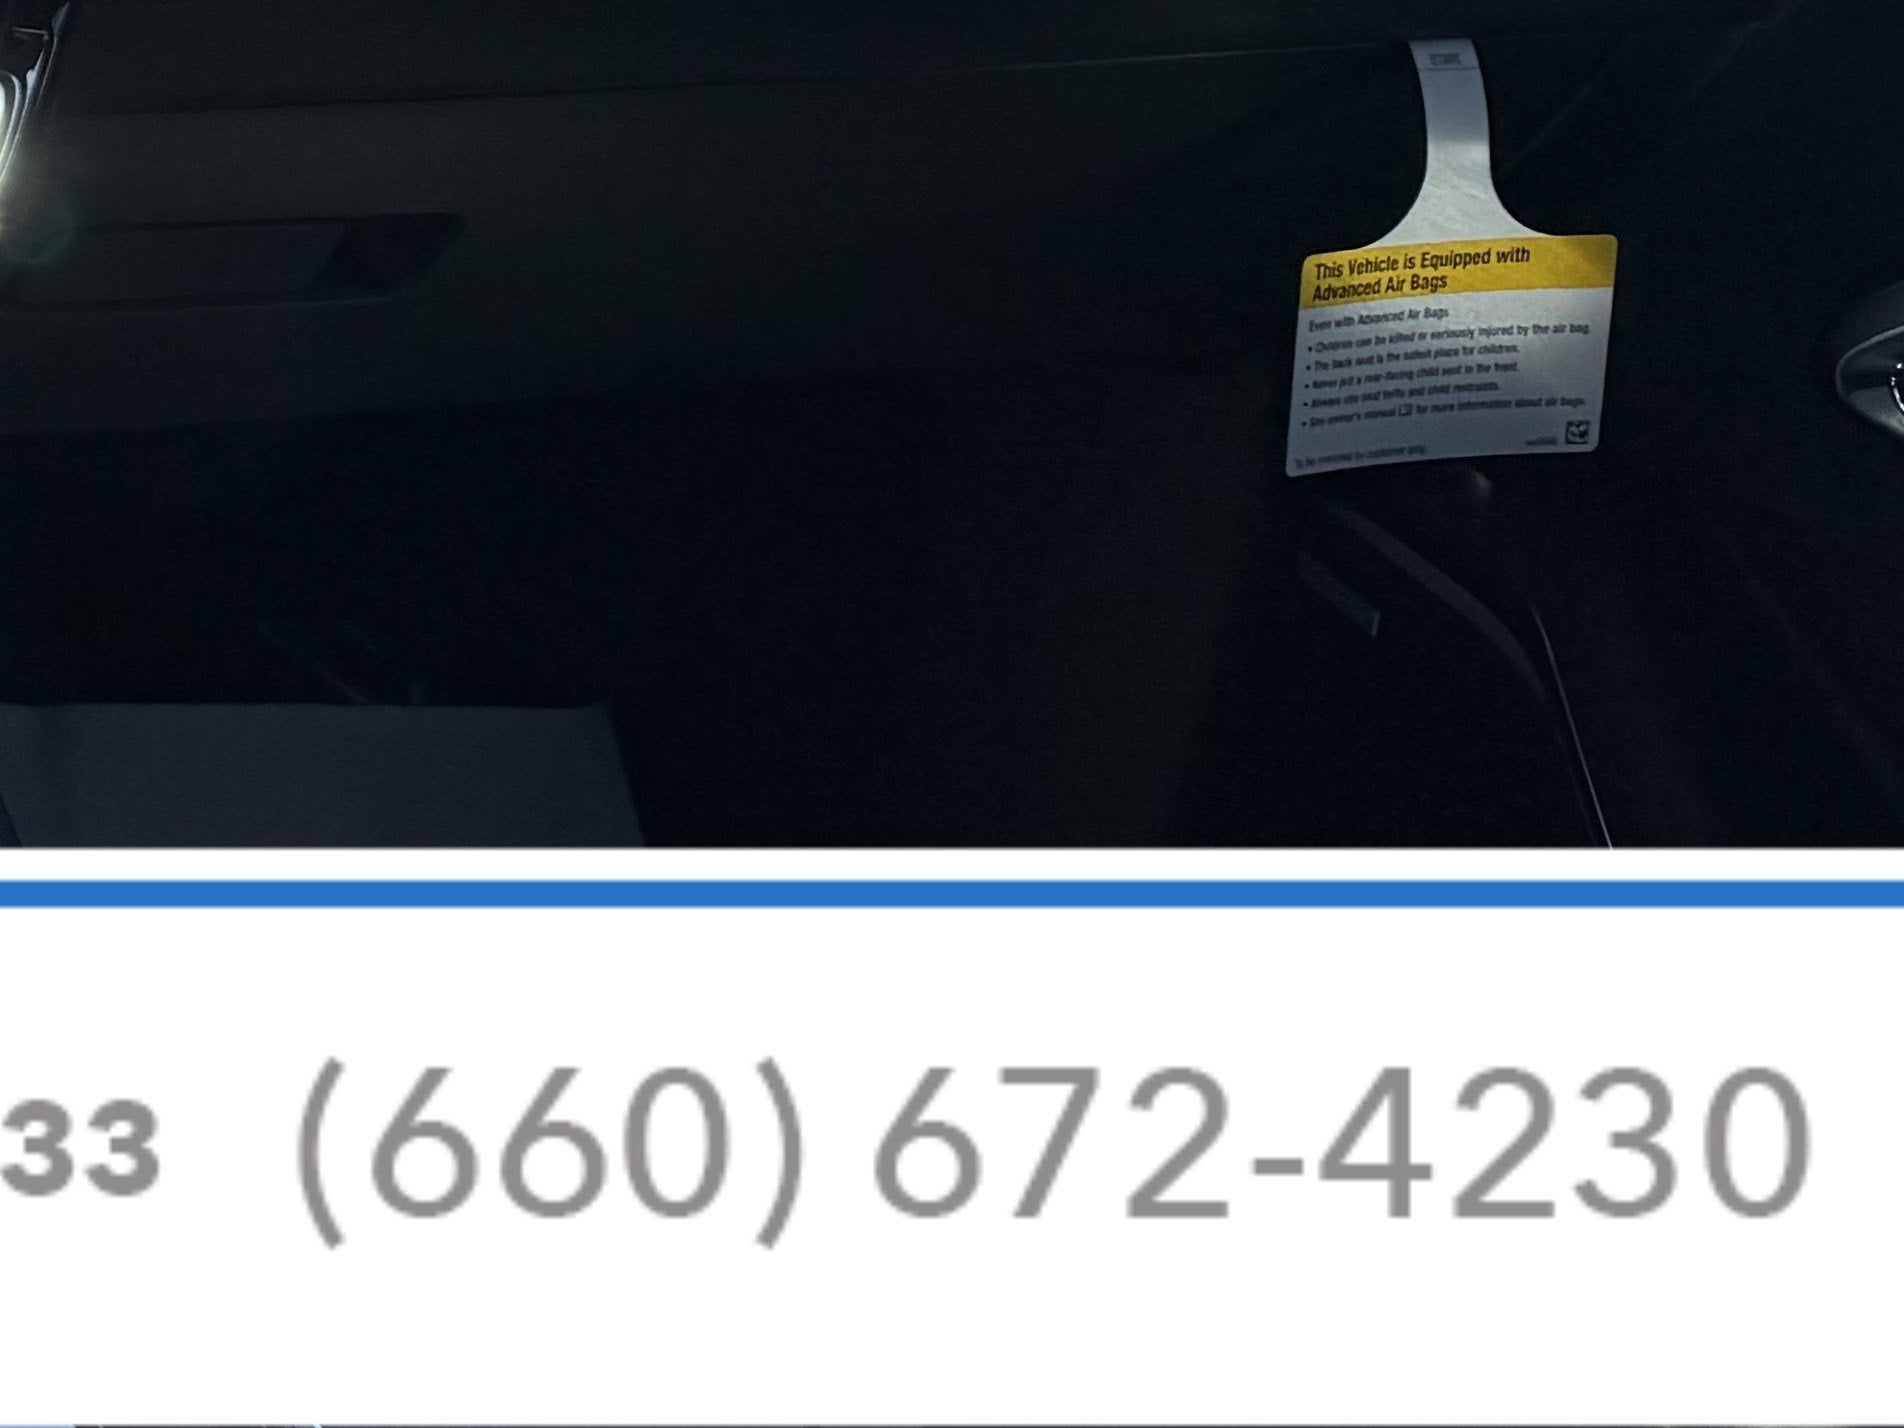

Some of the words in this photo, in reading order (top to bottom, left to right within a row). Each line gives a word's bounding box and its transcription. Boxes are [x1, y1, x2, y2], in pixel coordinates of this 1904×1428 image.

[1315, 262, 1344, 281] This
[1348, 255, 1399, 277] Vehicle
[1403, 253, 1416, 271] is
[1421, 248, 1491, 270] Equipped
[1496, 246, 1531, 263] with
[1312, 280, 1381, 302] Advanced
[1385, 275, 1406, 293] Air
[1410, 272, 1448, 295] Bags
[1517, 325, 1529, 336] by
